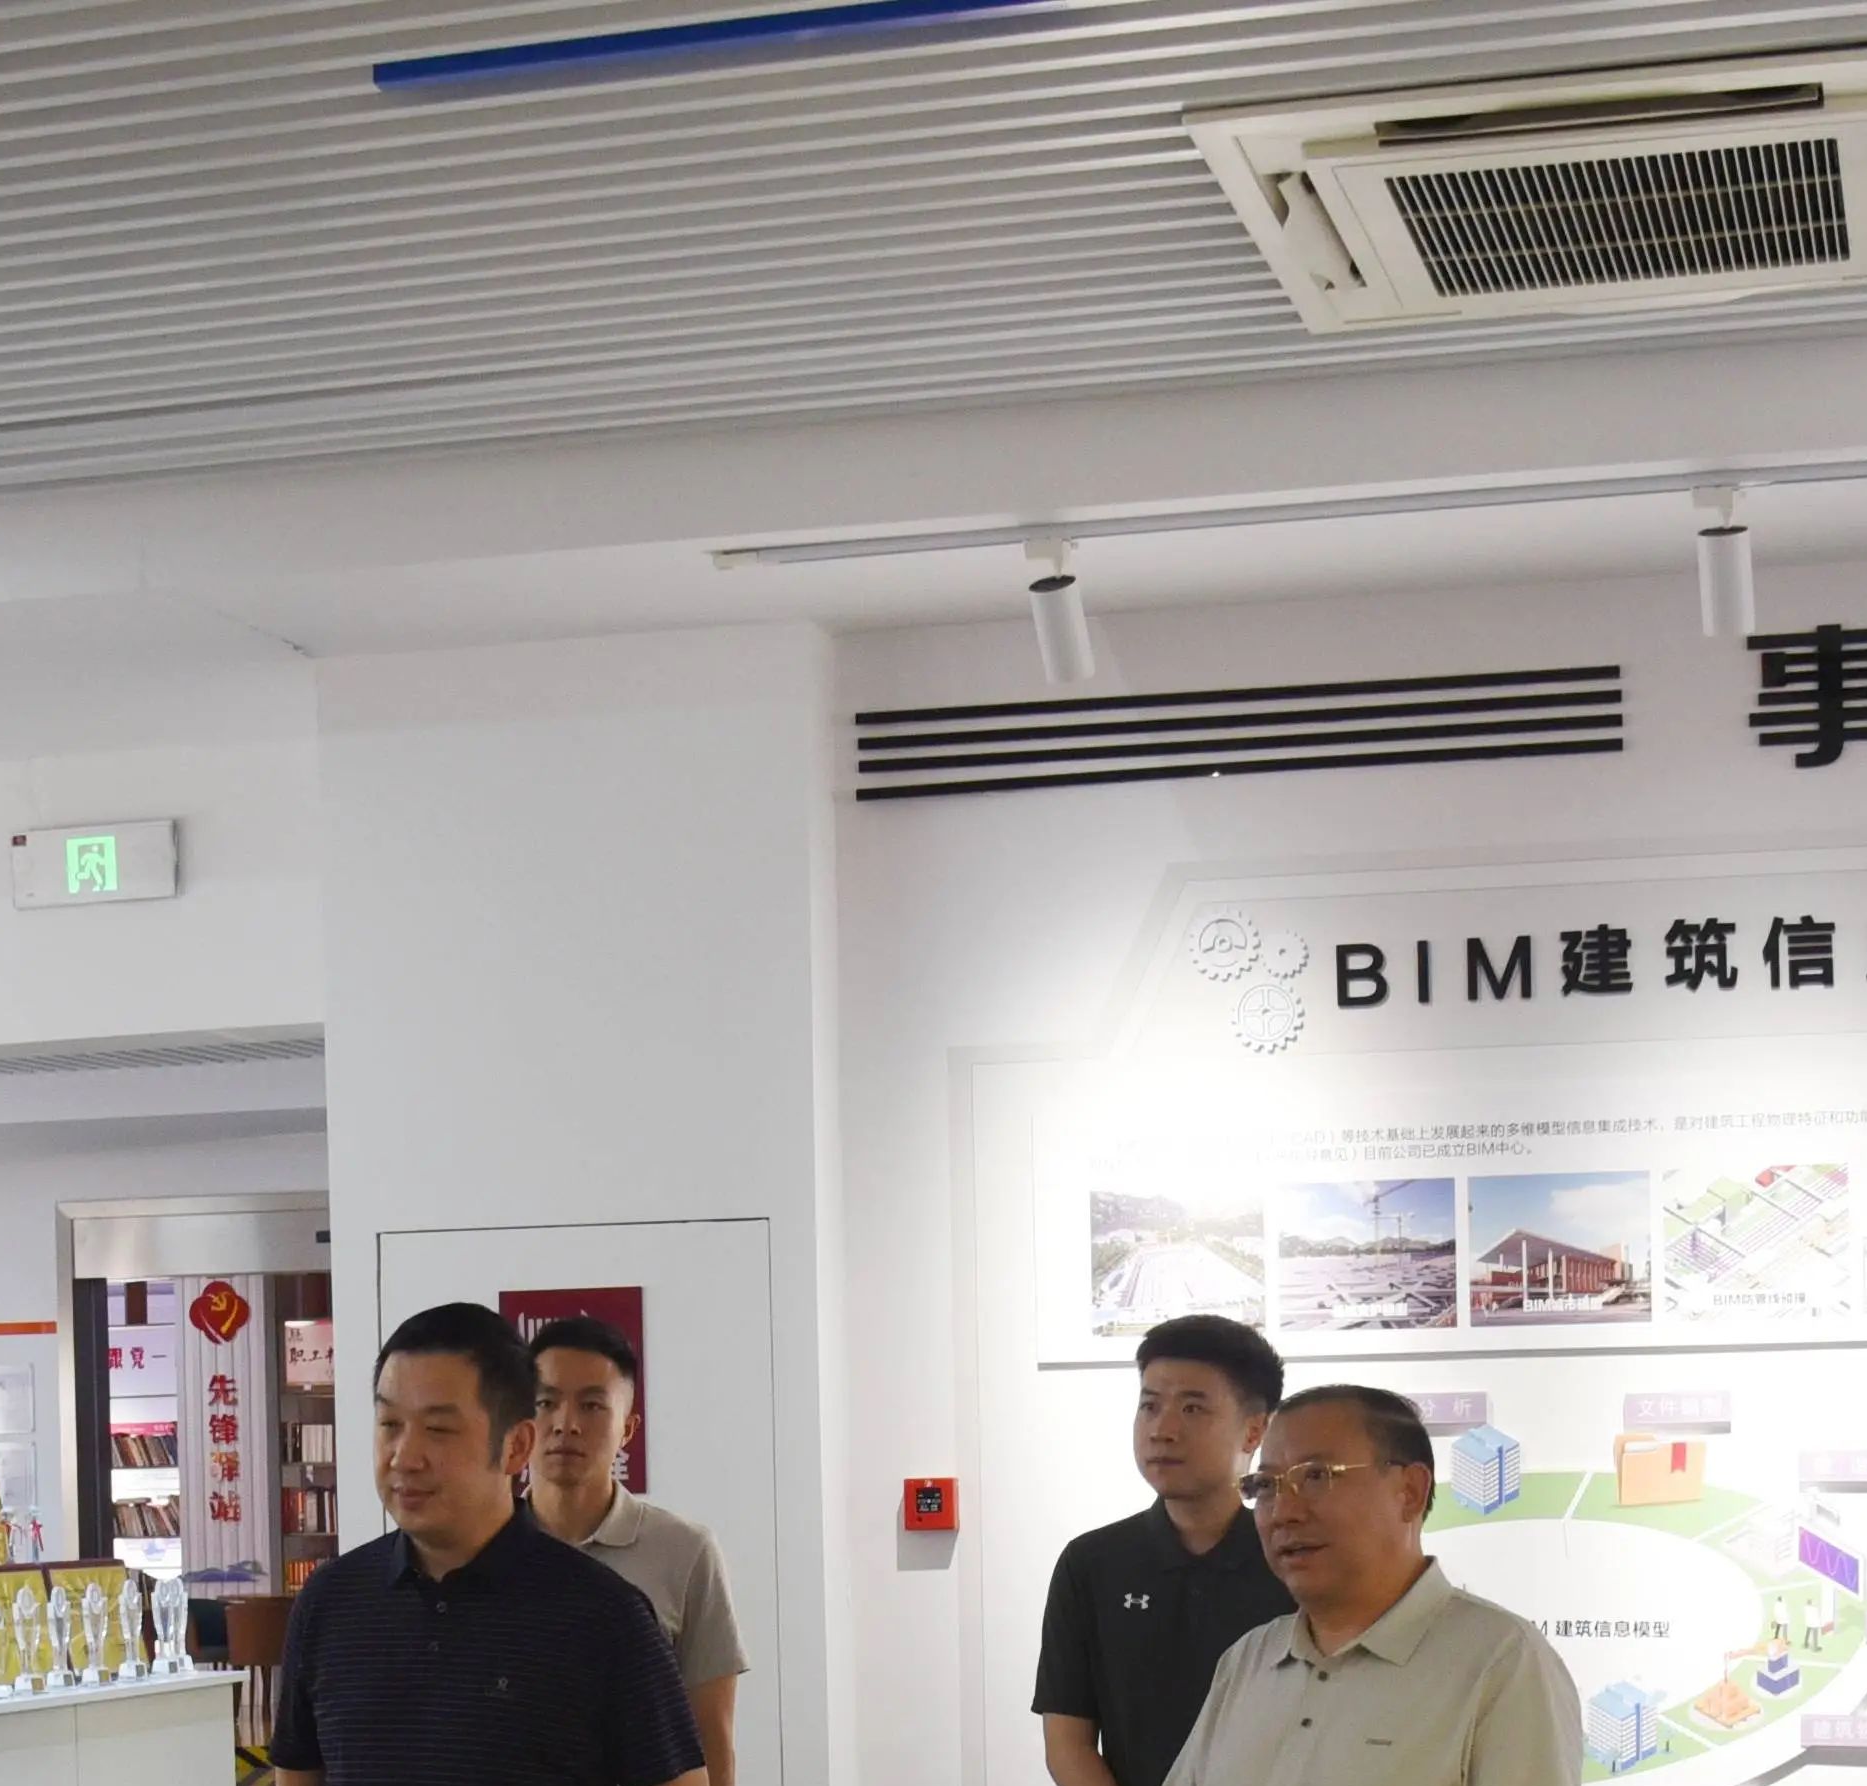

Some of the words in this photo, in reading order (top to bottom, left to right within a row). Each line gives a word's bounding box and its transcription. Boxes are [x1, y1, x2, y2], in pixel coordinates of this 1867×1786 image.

[1555, 1618, 1671, 1639] 建筑信息模型
